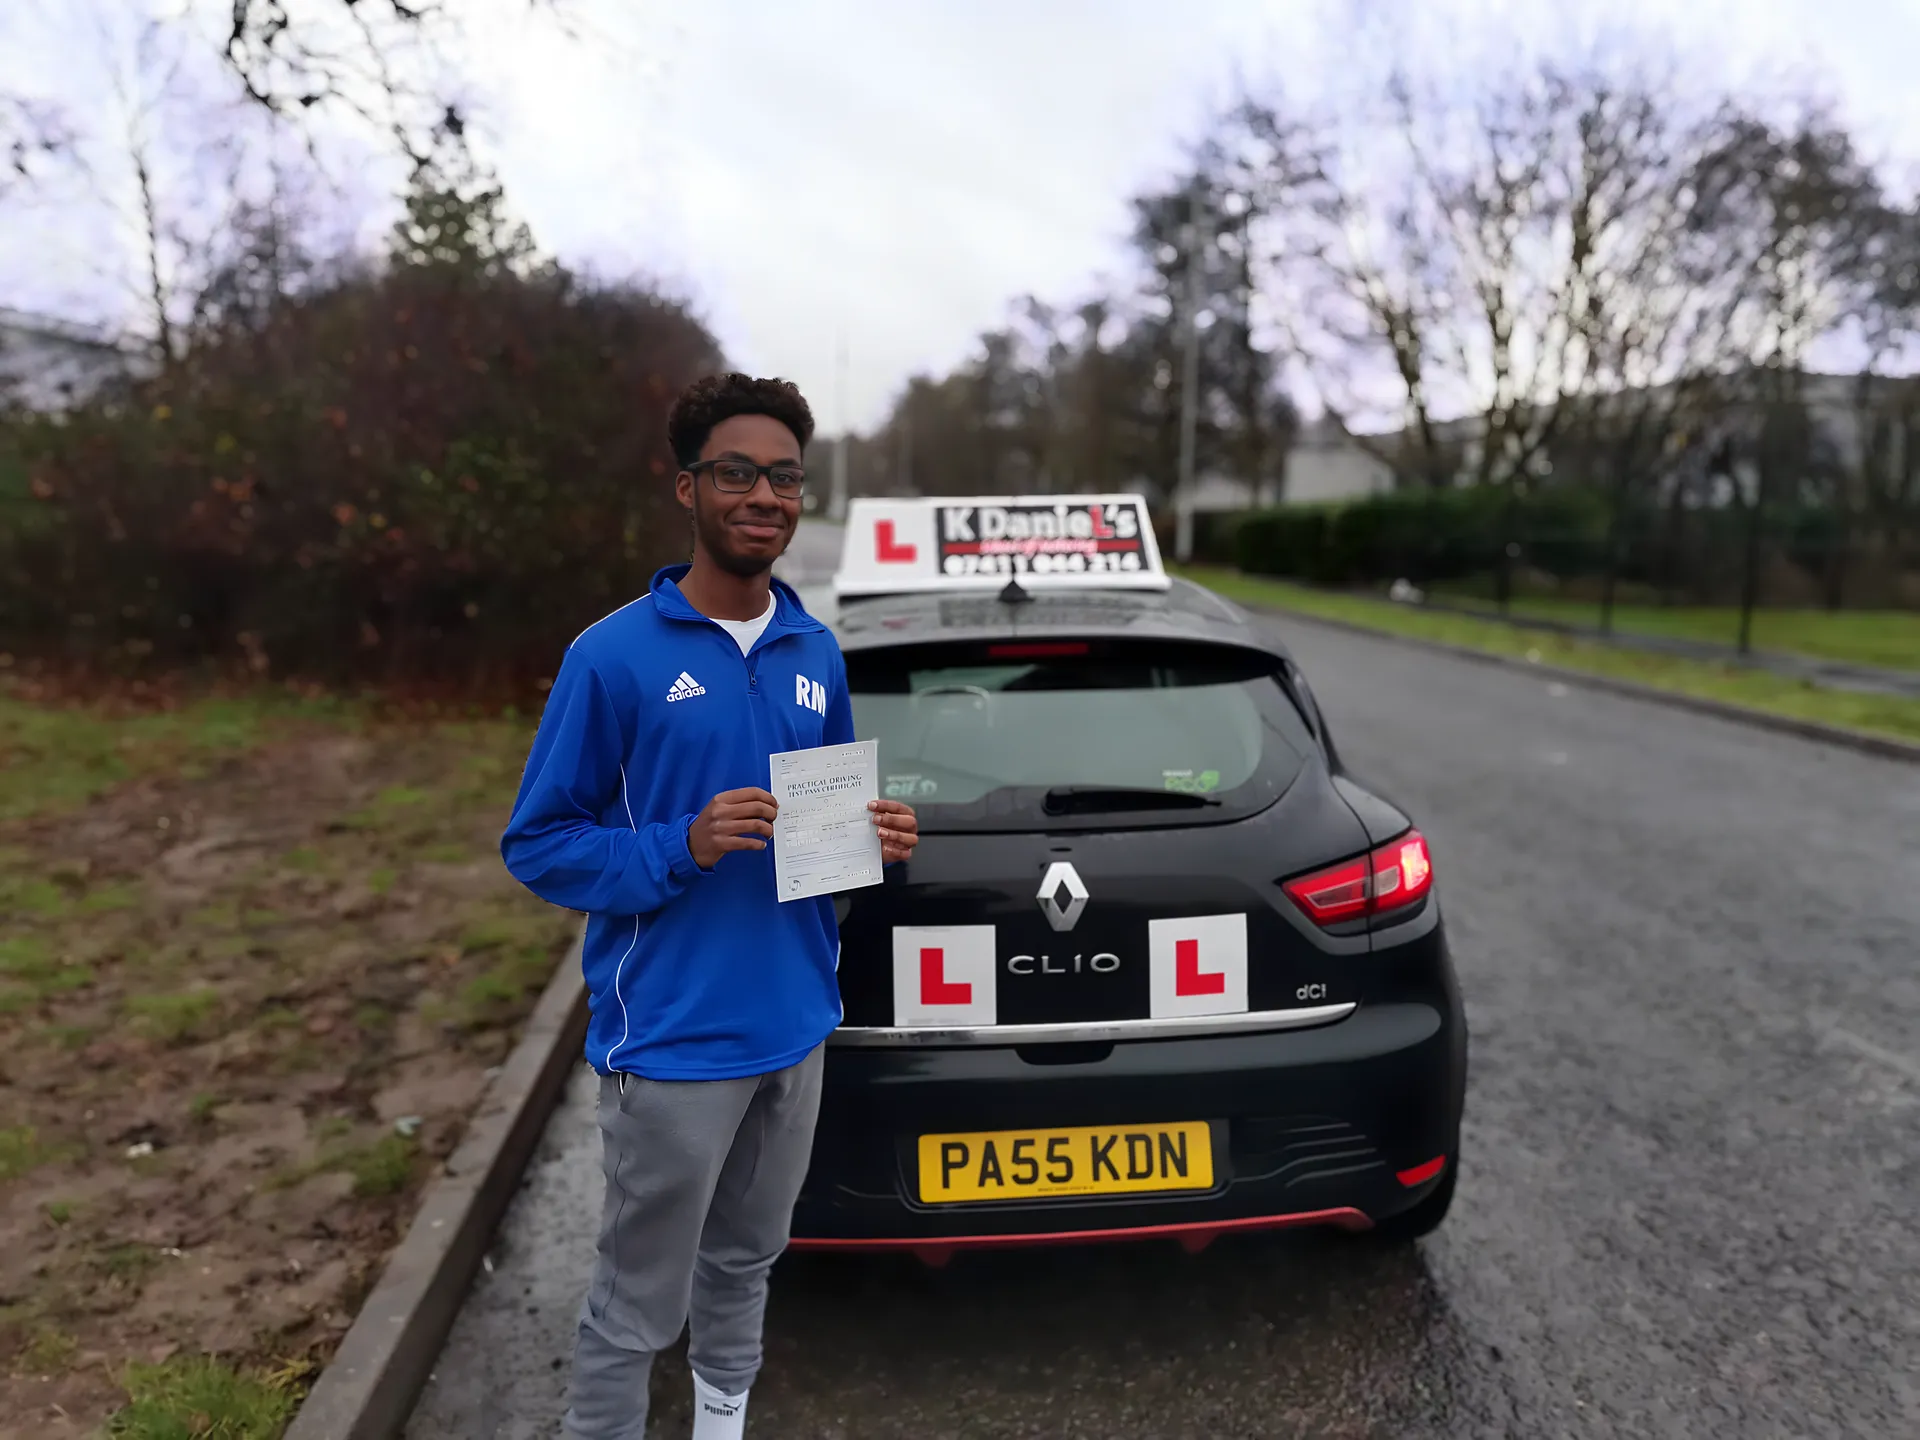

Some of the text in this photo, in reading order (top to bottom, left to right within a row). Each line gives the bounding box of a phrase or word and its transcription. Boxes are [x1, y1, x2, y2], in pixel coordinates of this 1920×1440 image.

[875, 519, 917, 562] L
[943, 507, 975, 541] K
[666, 686, 706, 702] adidas
[796, 674, 826, 717] RM
[787, 774, 862, 791] PRACTICAL DRIVING
[788, 781, 862, 798] TEST PASS CERTIFICATE
[920, 948, 972, 1005] L
[1007, 953, 1121, 975] CLIO
[1176, 939, 1225, 996] L
[941, 1131, 1189, 1190] PA55 KDN
